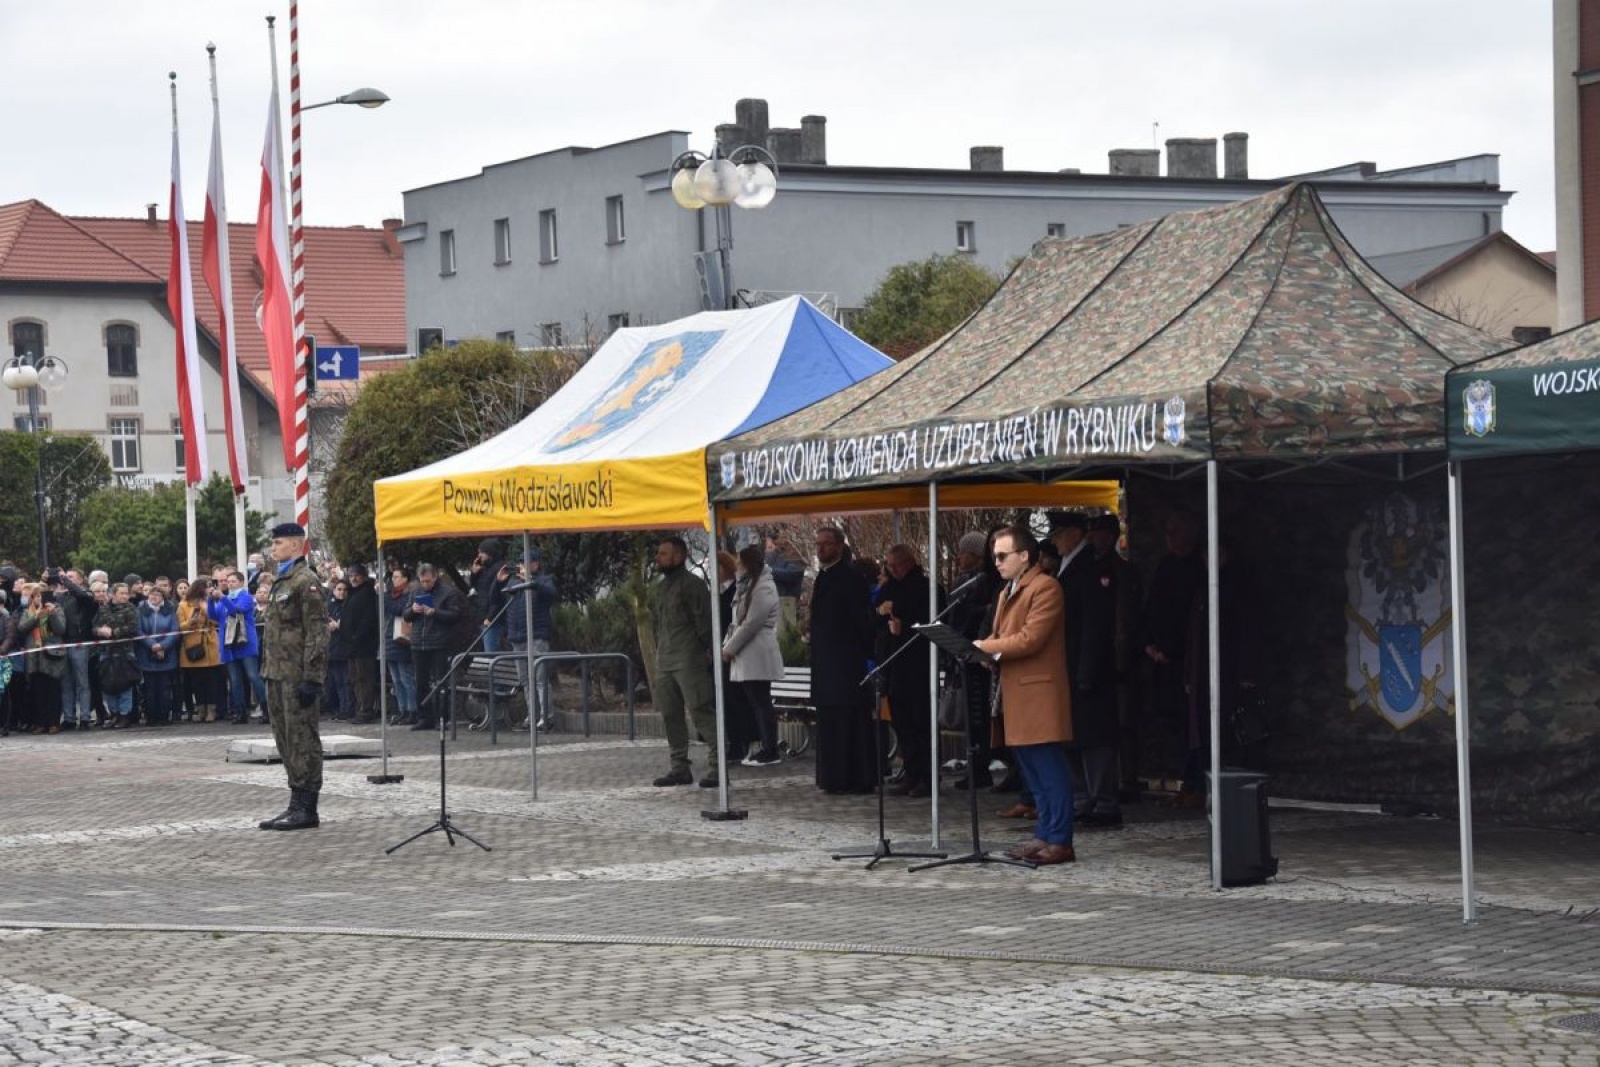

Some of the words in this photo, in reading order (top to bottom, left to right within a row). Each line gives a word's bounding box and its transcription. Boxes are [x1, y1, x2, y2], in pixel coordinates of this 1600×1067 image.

[1533, 367, 1600, 397] WOJSK
[742, 440, 829, 488] WOJSKOWA
[833, 428, 917, 479] KOMENDA
[923, 405, 1039, 469] UZUPEŁNIEŃ
[1043, 407, 1063, 457] W
[1066, 402, 1158, 456] RYBNIKU
[499, 469, 613, 513] Wodzisławski
